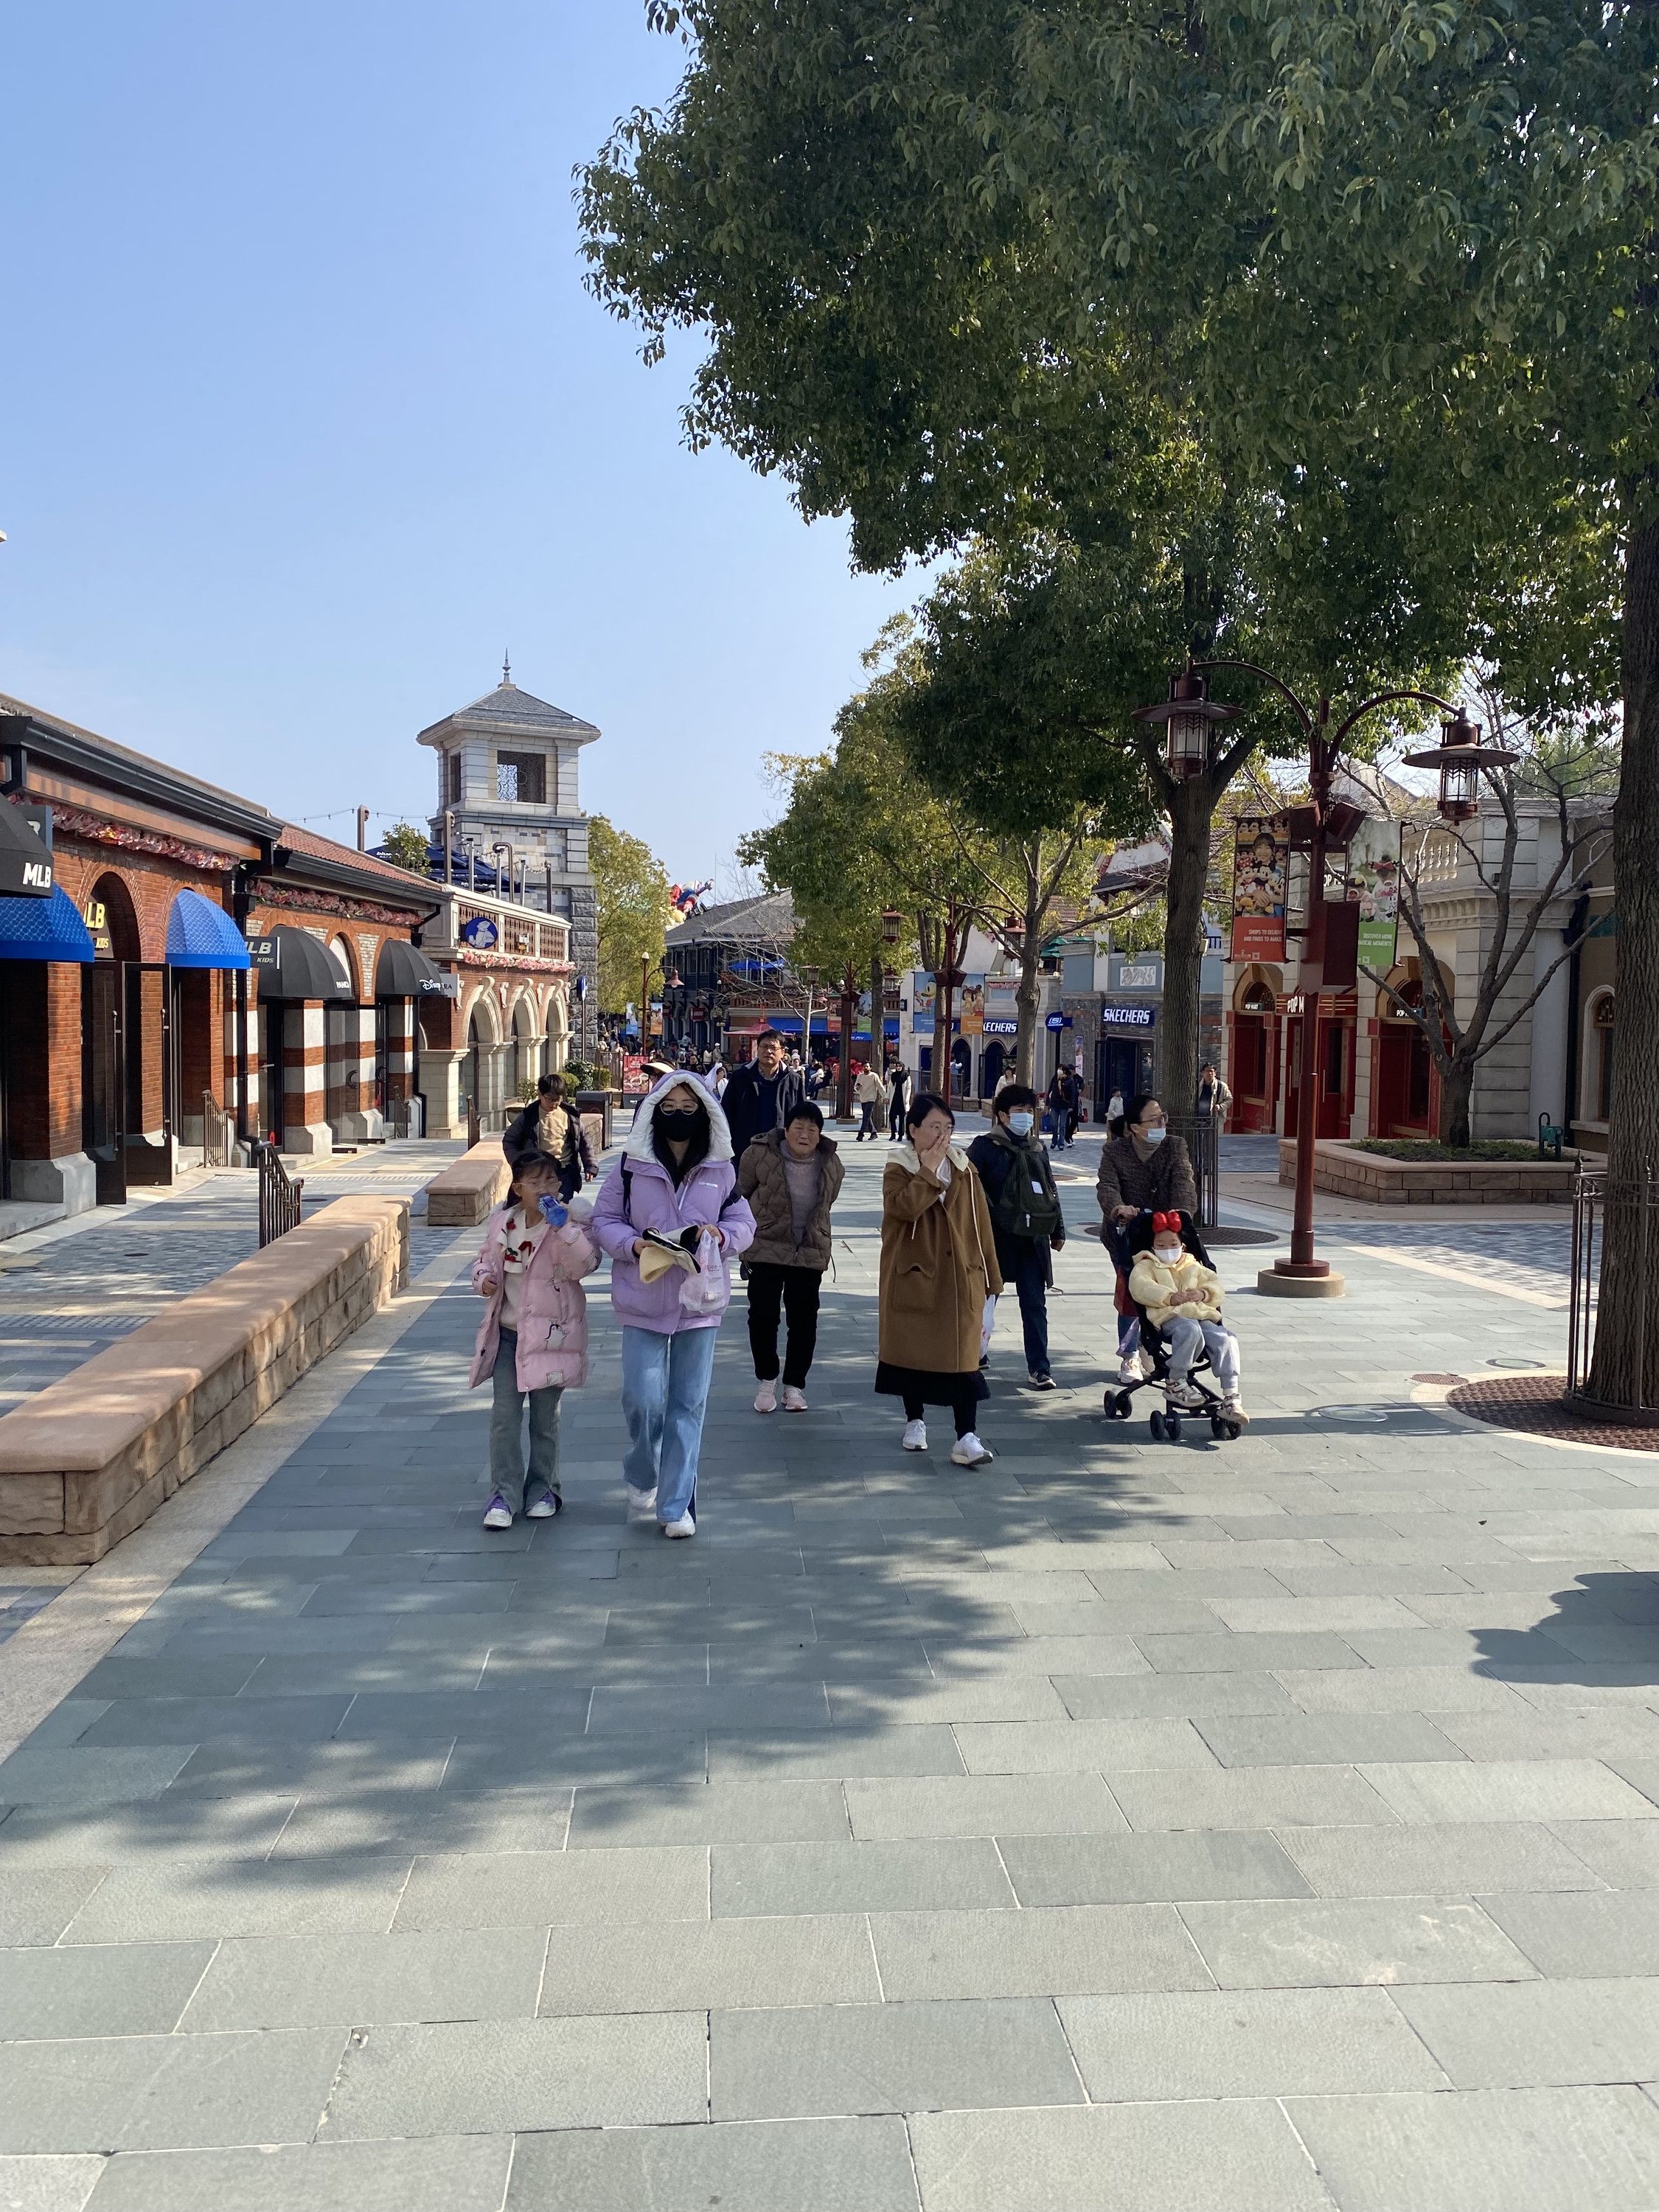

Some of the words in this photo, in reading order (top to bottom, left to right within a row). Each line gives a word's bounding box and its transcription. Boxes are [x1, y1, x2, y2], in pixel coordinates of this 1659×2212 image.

[22, 862, 52, 888] MLB
[83, 902, 105, 929] LB
[96, 937, 109, 949] KIDS
[246, 941, 272, 955] LB
[1287, 995, 1298, 1013] POP
[1103, 1008, 1150, 1024] SKECHERS
